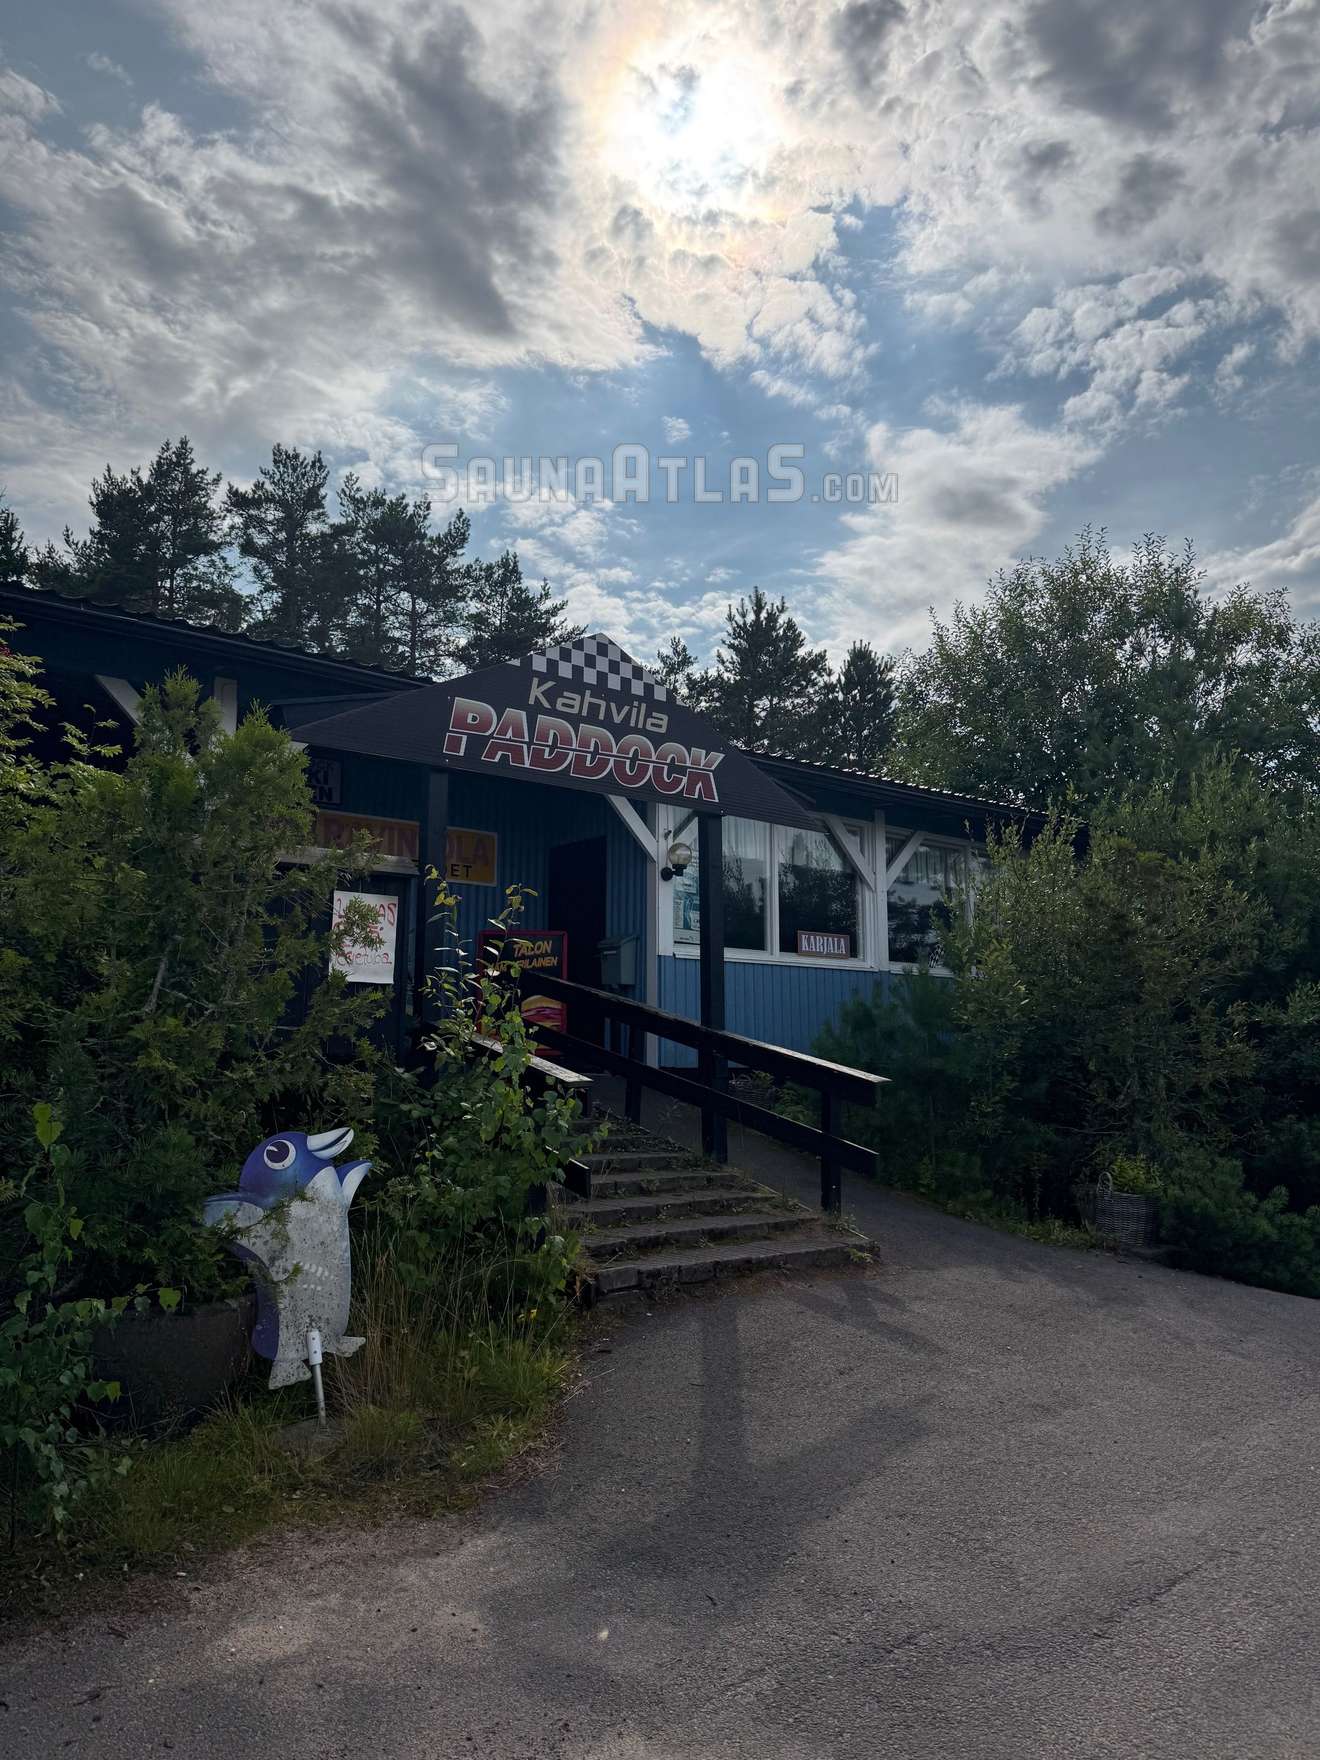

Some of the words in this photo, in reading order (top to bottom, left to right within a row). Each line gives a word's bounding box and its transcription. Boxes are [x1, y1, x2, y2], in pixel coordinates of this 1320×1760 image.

[528, 677, 669, 734] Kahvila
[443, 697, 725, 802] PADDOCK
[801, 934, 847, 955] KARJALA
